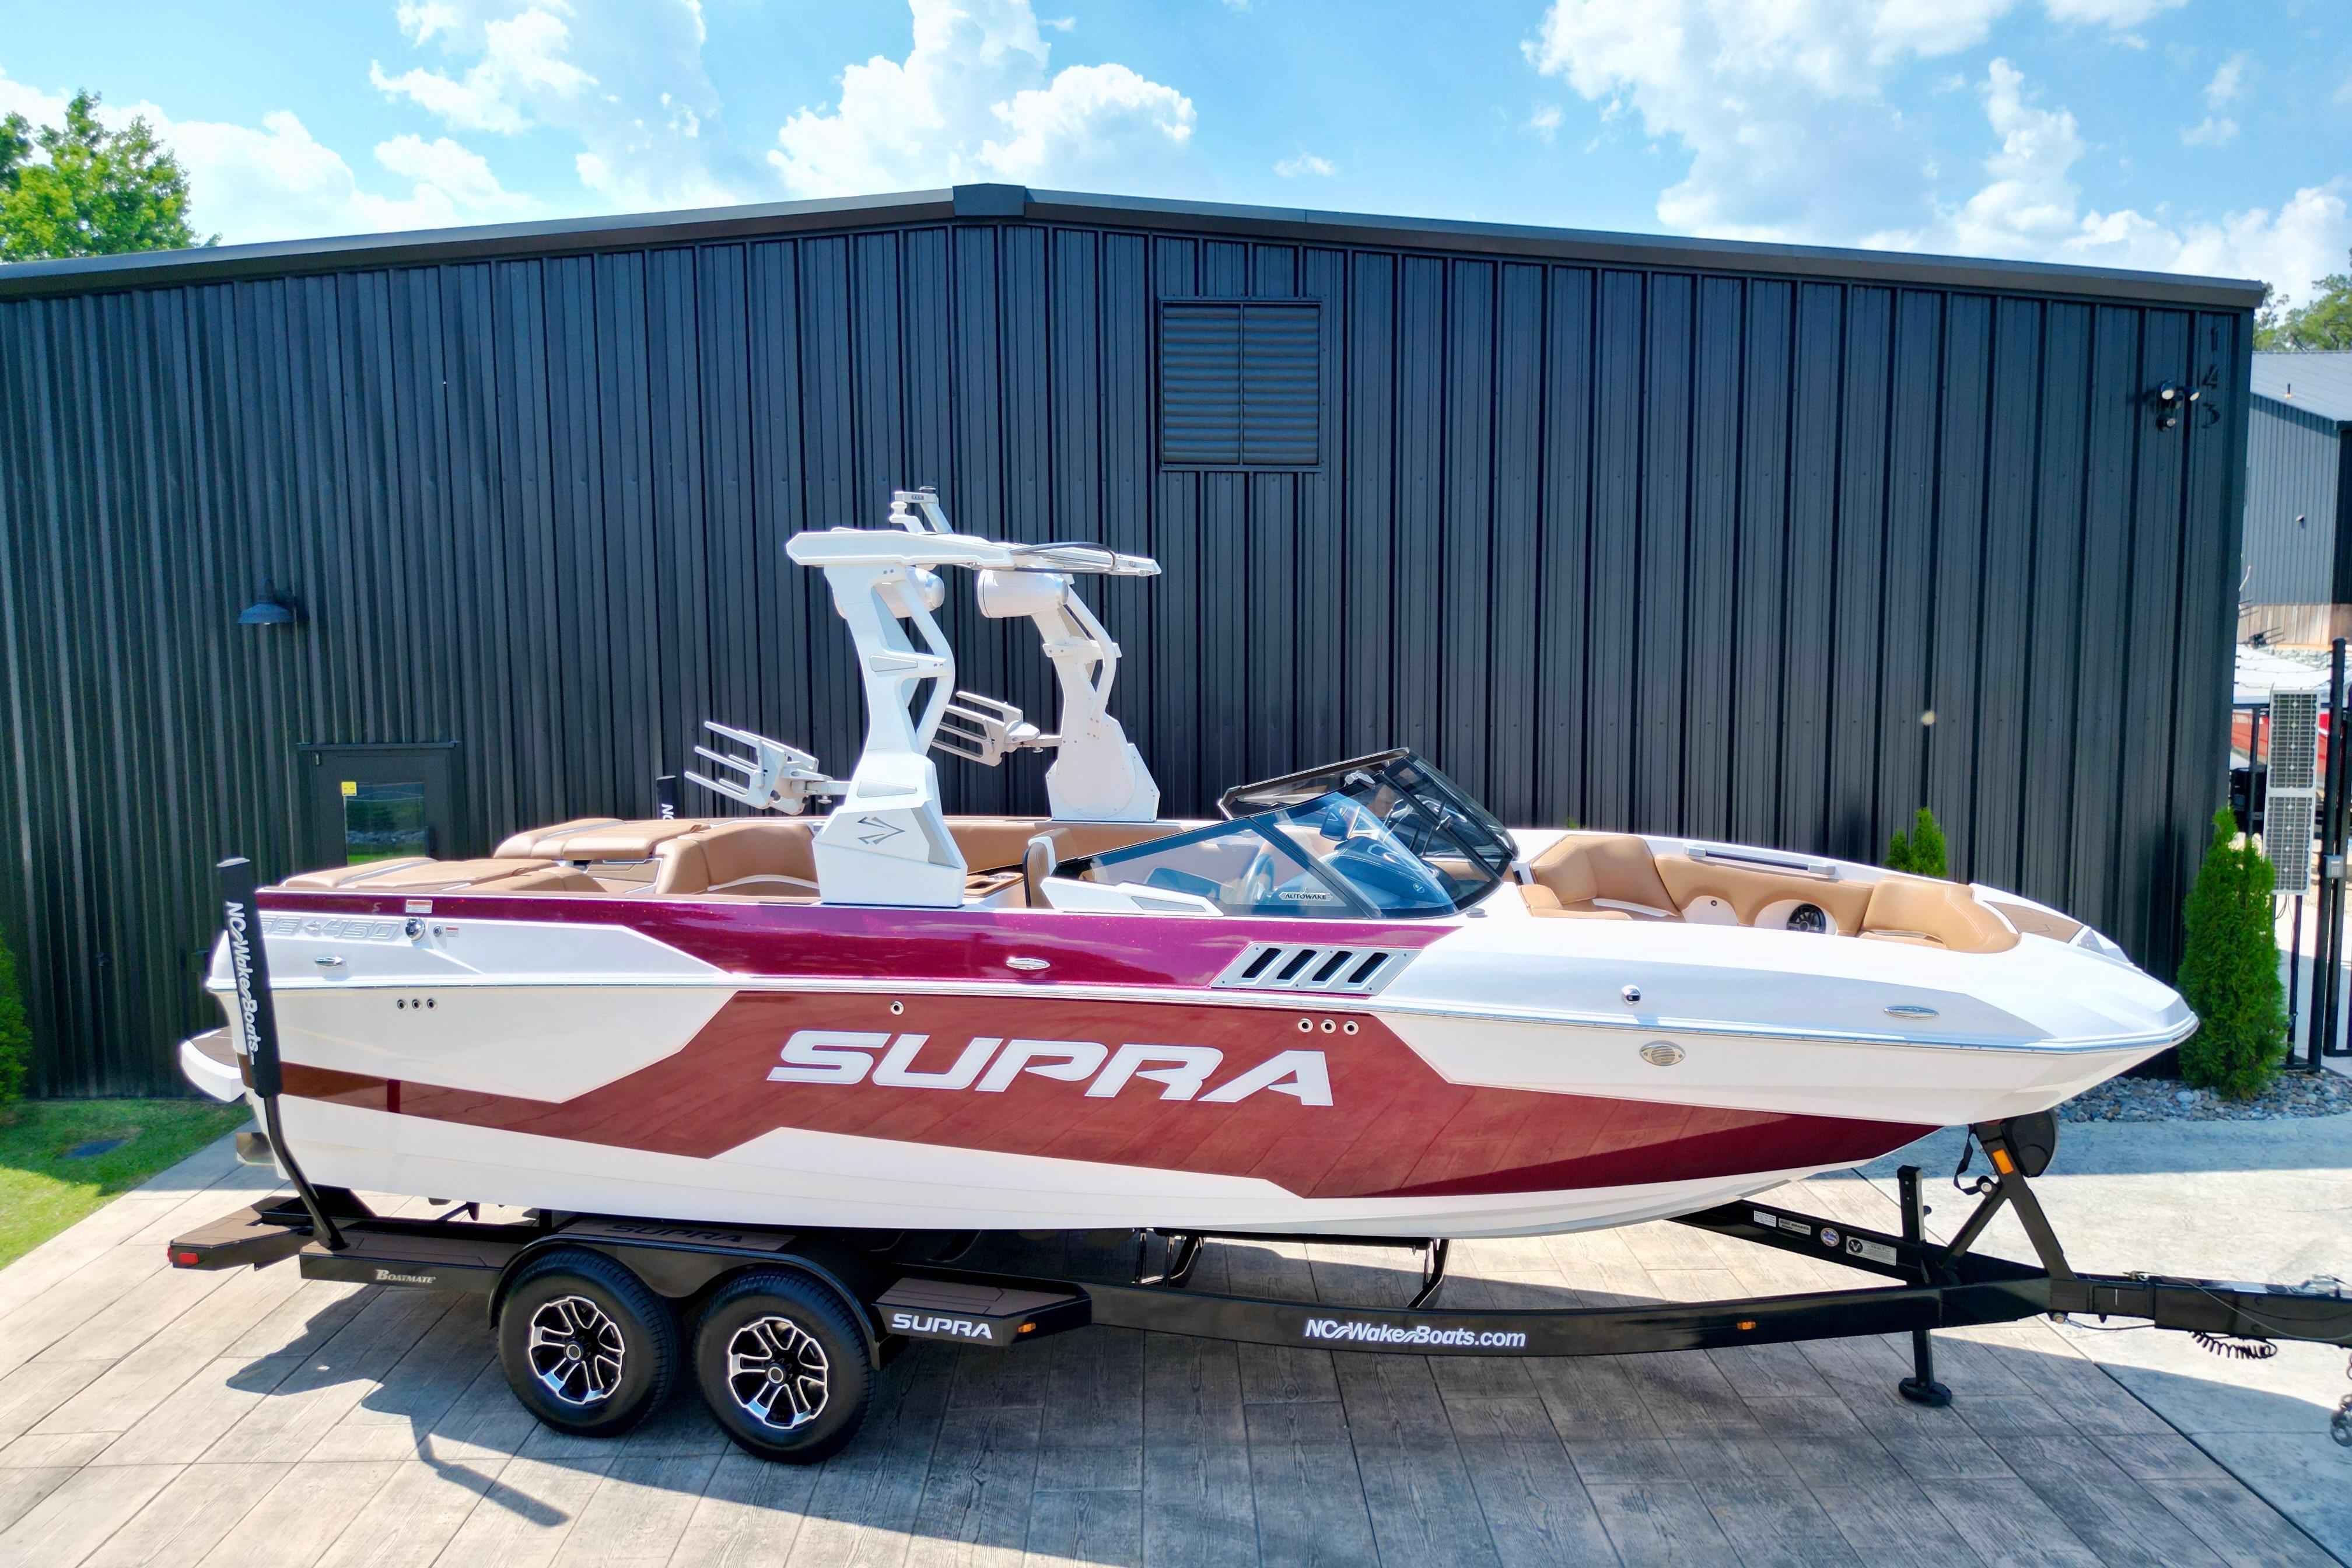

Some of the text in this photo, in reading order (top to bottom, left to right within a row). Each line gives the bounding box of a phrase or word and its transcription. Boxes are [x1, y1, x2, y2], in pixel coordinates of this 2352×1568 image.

[322, 919, 400, 939] 450
[765, 1030, 1334, 1107] SUPRA
[604, 1224, 743, 1242] SUPRA
[892, 1313, 992, 1339] SUPRA
